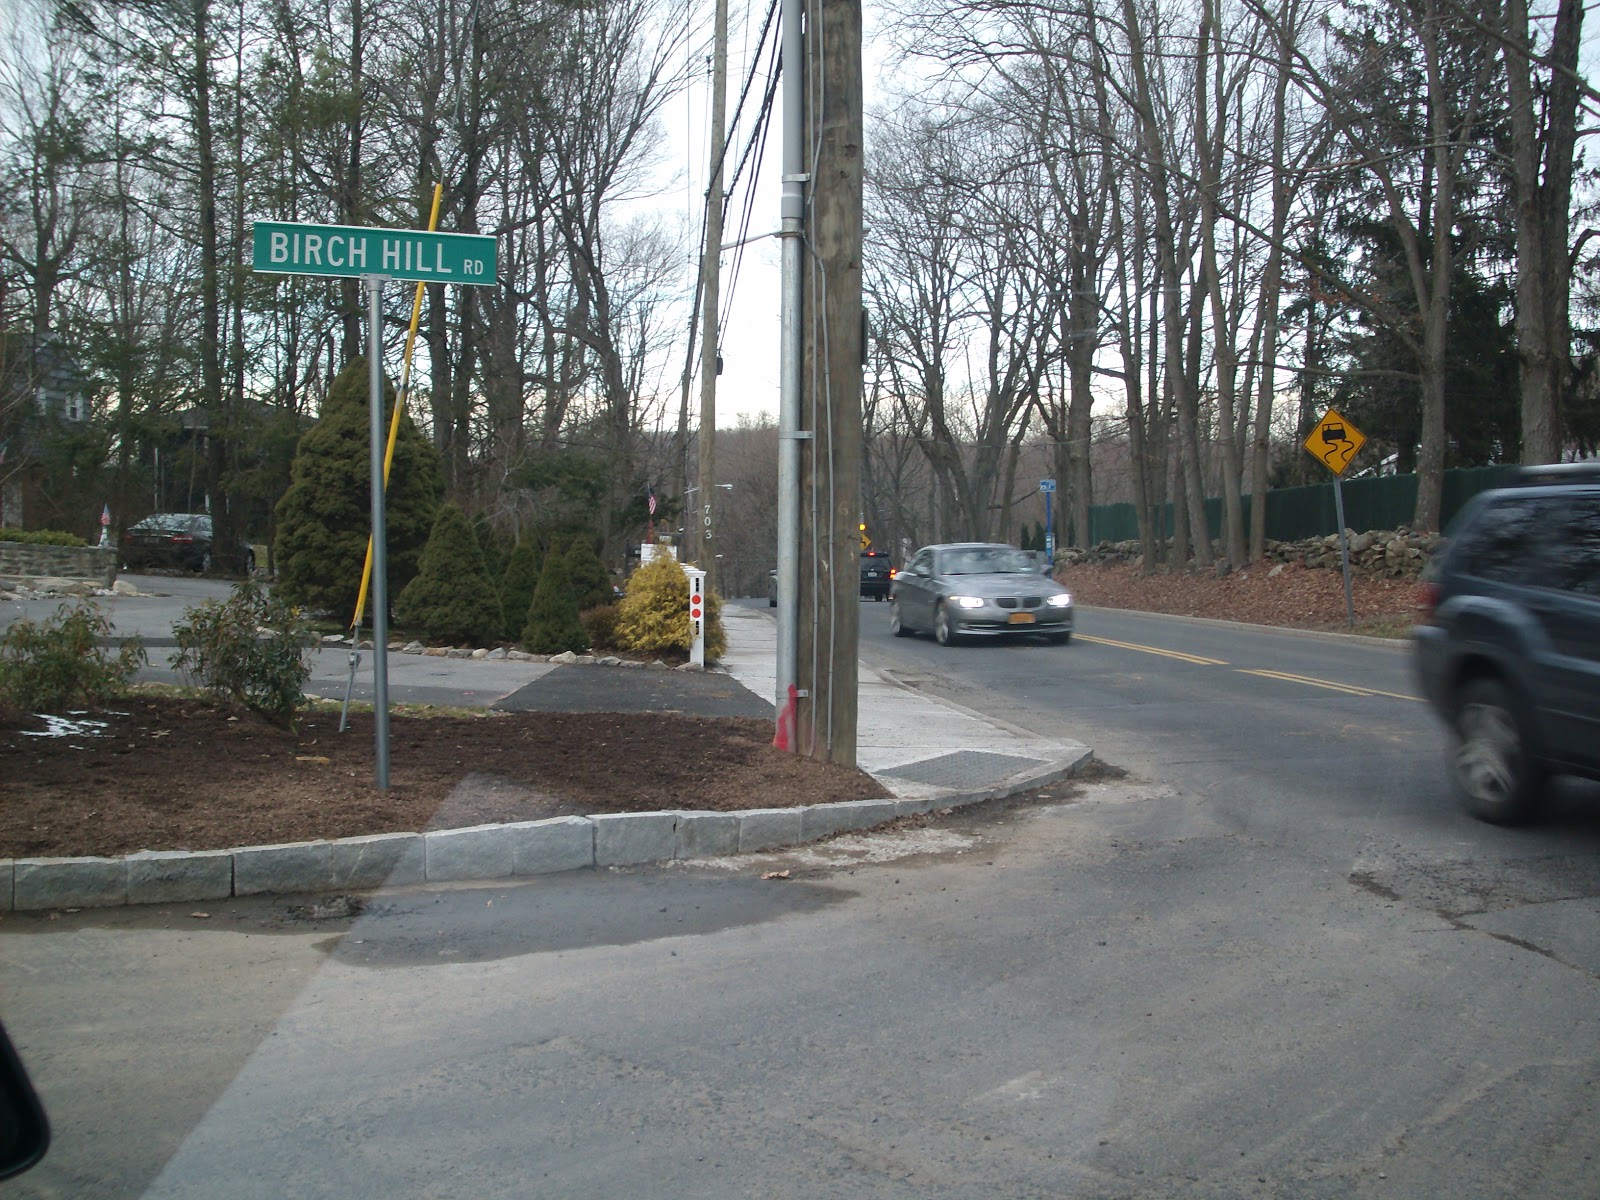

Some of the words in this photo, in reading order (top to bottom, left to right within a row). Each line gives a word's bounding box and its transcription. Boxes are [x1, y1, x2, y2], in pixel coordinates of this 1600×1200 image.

[270, 232, 367, 268] BIRCH
[382, 239, 452, 274] HILL
[463, 259, 484, 275] RD
[704, 504, 712, 539] 703
